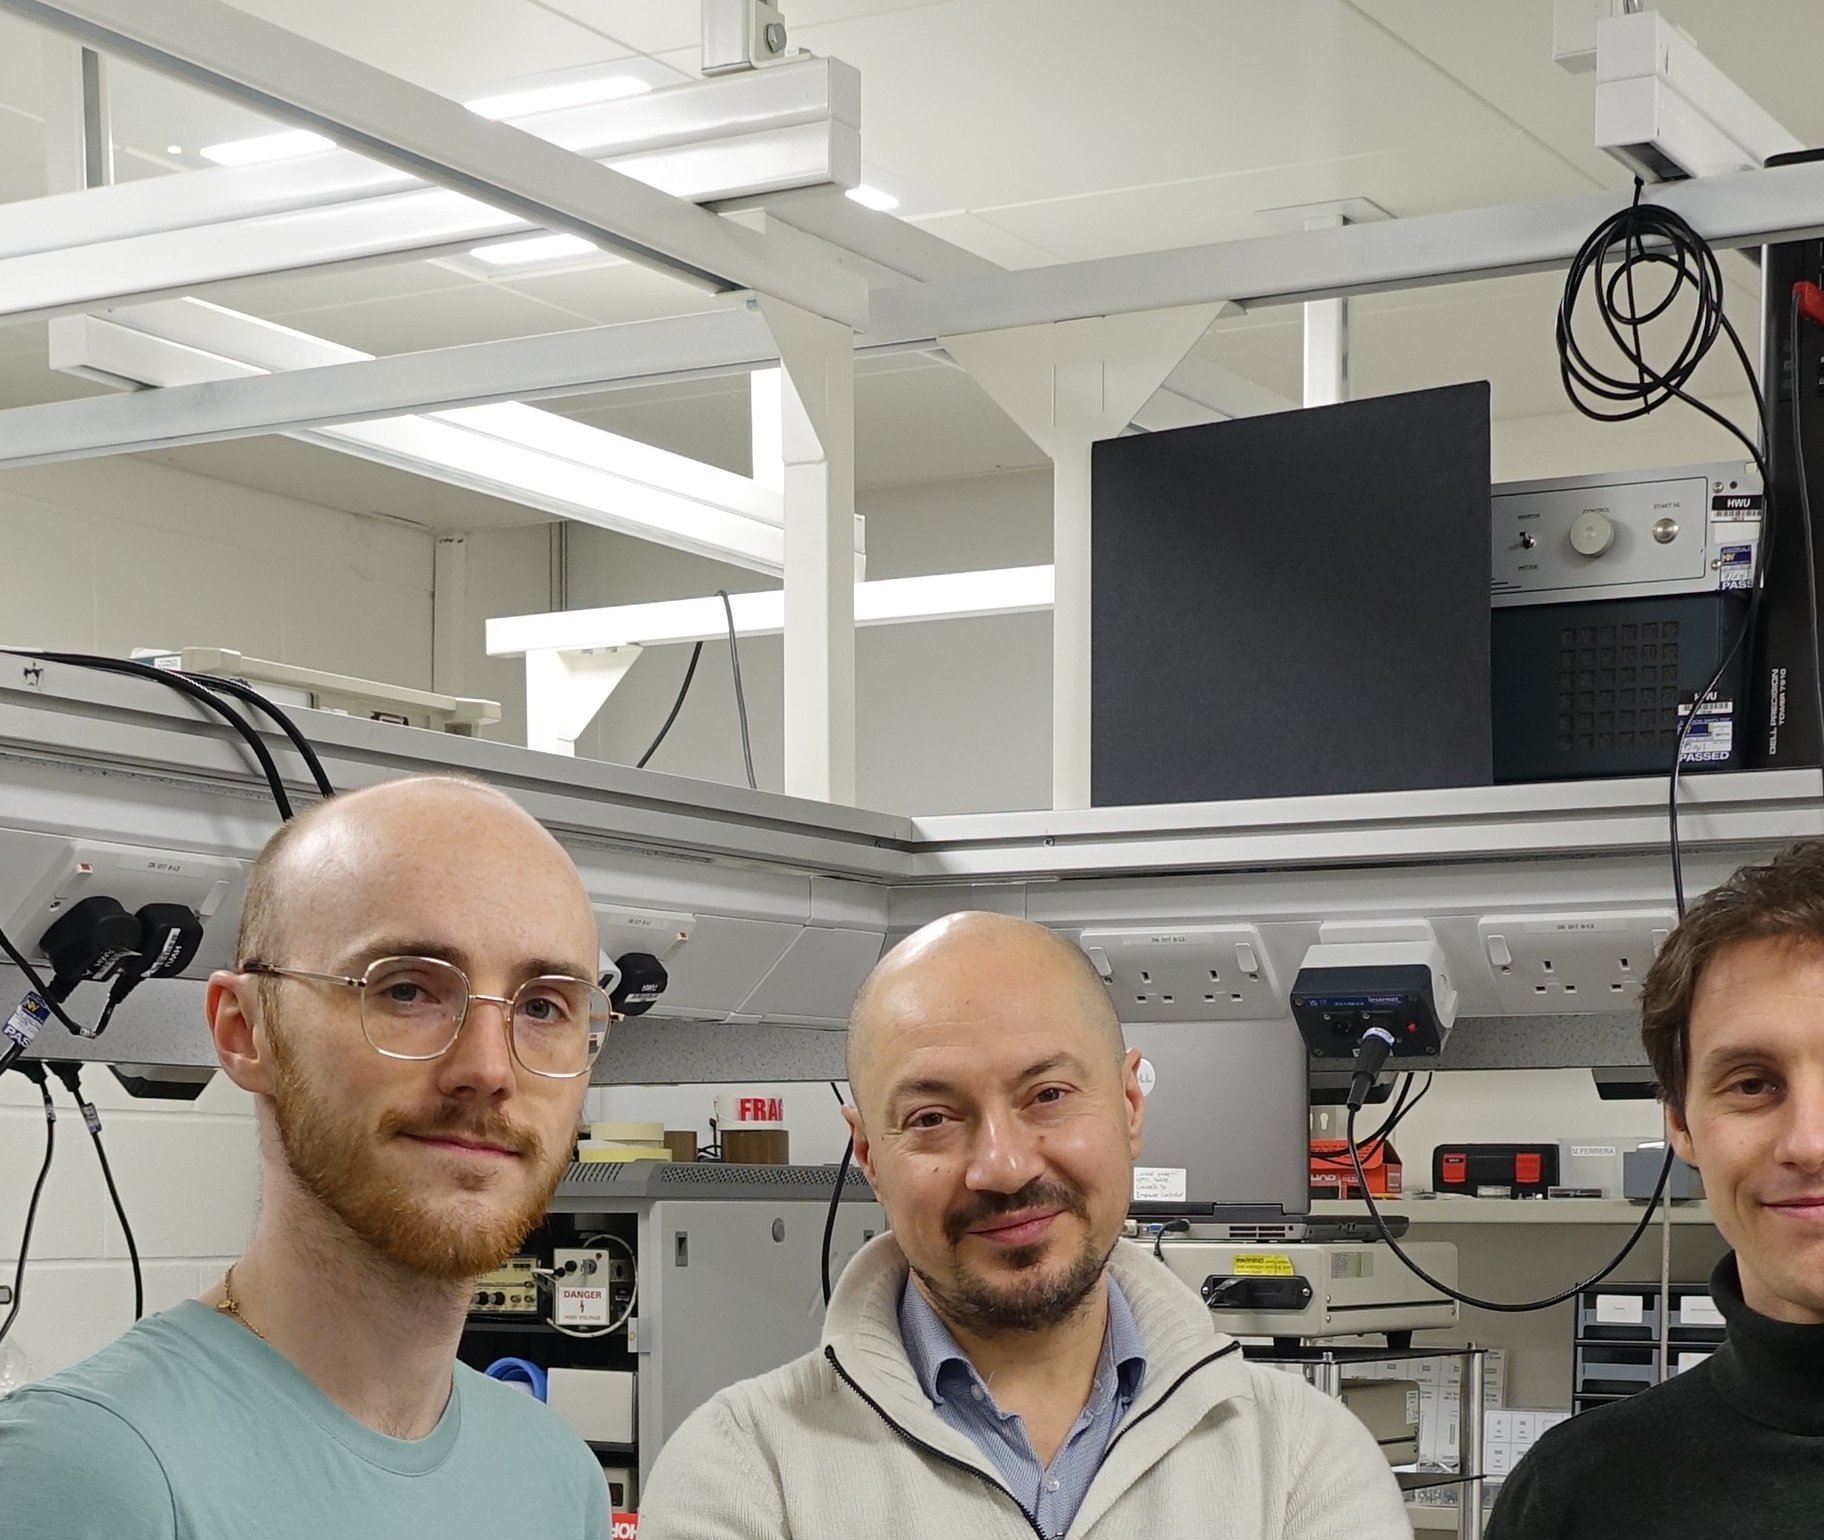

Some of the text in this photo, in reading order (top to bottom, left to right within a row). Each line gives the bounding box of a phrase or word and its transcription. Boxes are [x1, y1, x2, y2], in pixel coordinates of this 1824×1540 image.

[1726, 498, 1751, 509] HWU
[1769, 668, 1779, 755] DELL PRECISION
[1680, 752, 1730, 764] PASSED
[563, 1290, 602, 1299] DANGER
